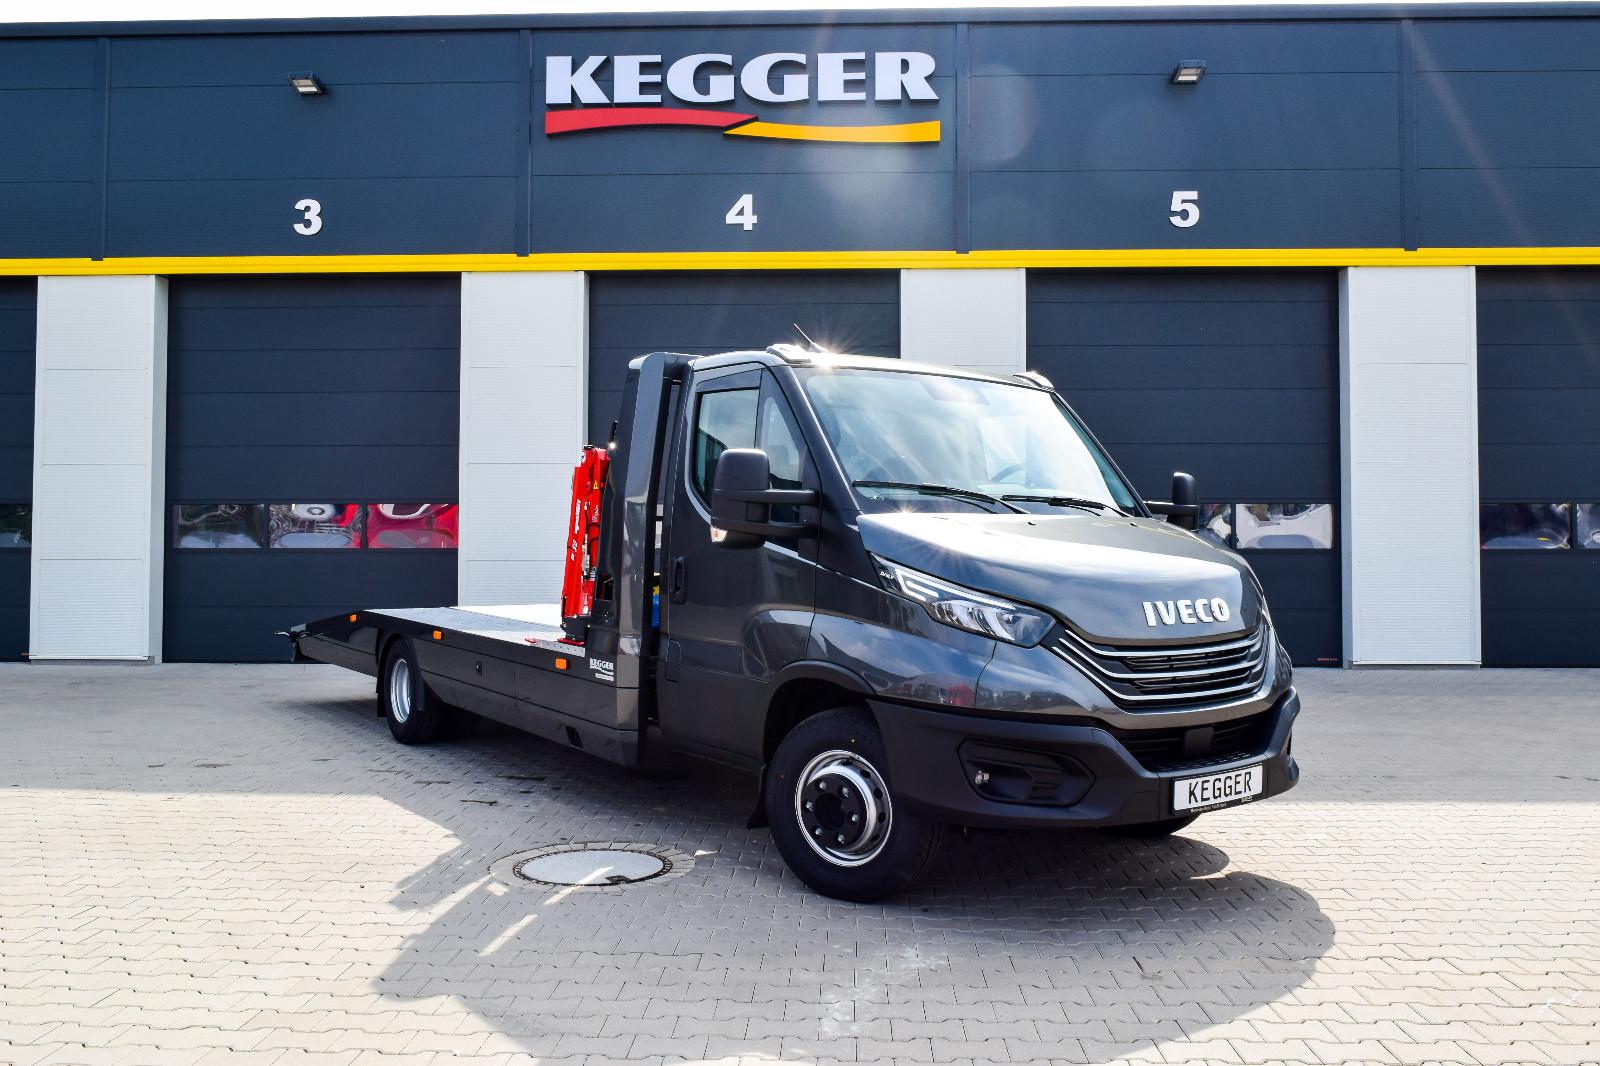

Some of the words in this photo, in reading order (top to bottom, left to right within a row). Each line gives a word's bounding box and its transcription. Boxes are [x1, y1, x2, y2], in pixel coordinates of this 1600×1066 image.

[545, 51, 940, 104] KEGGER
[293, 198, 323, 236] 3
[725, 193, 758, 231] 4
[1169, 190, 1200, 228] 5
[1142, 598, 1230, 627] IVECO
[589, 658, 614, 670] KEGGER
[1188, 771, 1252, 804] KEGGER
